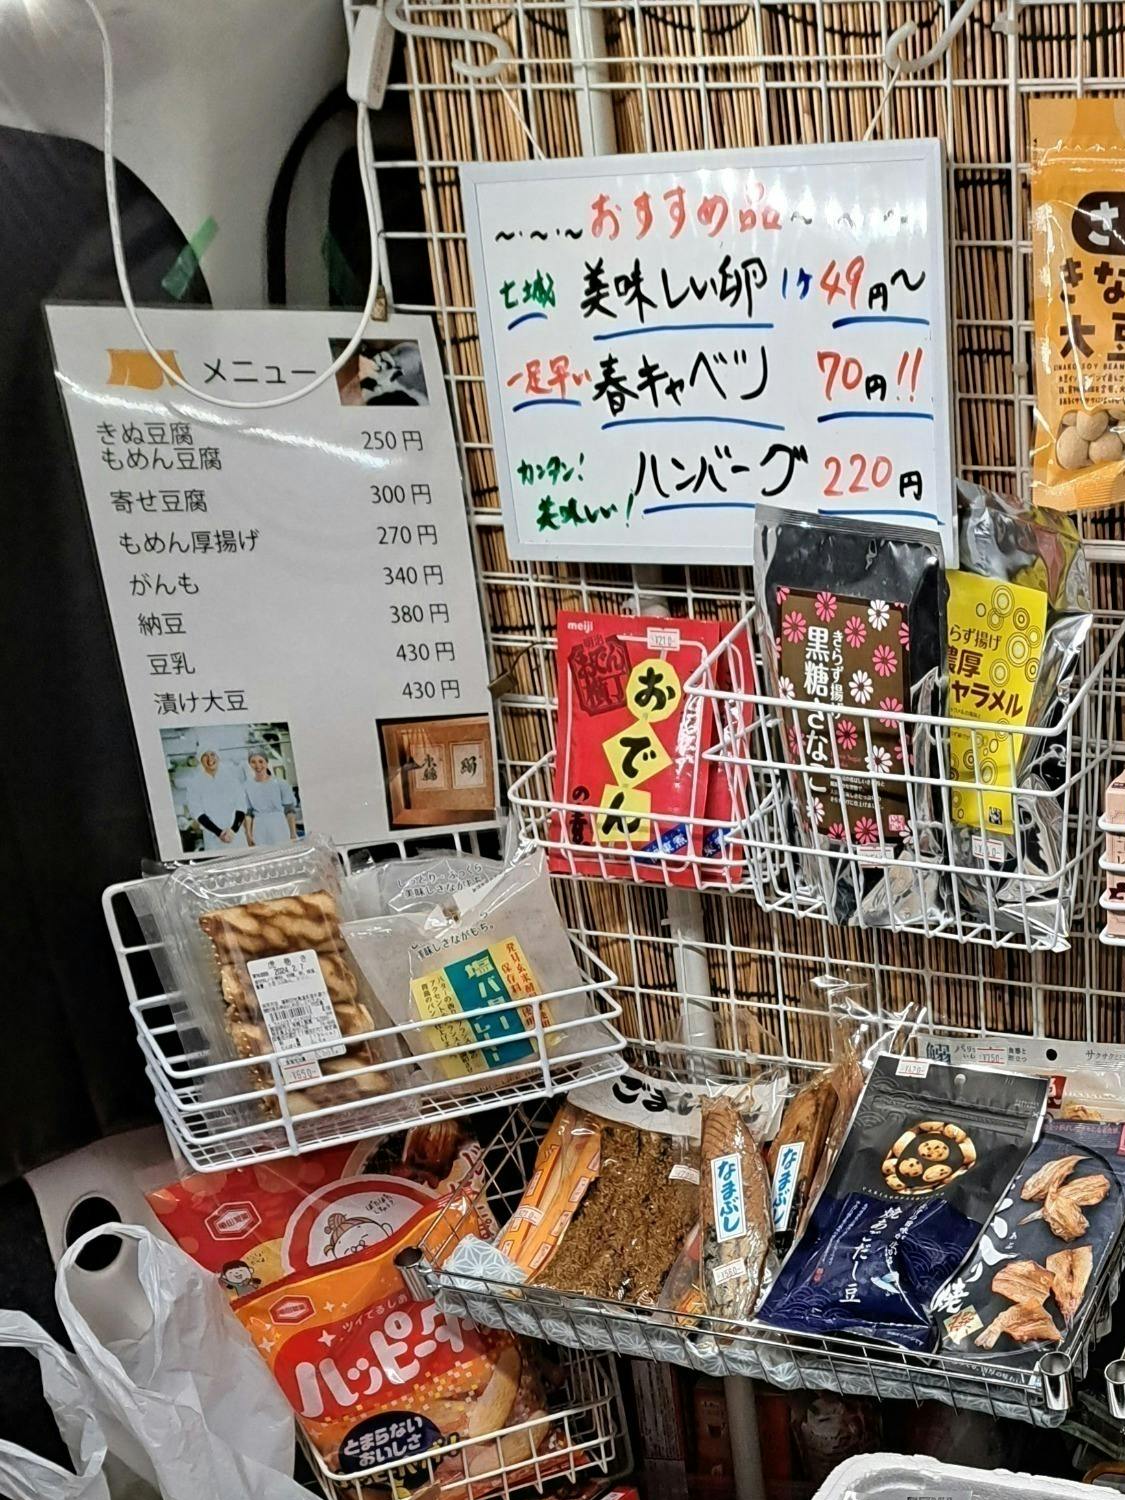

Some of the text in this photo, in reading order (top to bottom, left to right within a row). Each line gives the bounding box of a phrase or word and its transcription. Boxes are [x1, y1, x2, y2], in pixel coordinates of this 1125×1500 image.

[580, 254, 767, 322] 美味しい卵
[202, 358, 316, 386] メニュー
[592, 345, 767, 416] 春キャベツ
[1103, 363, 1125, 371] BEAN
[96, 421, 194, 447] きぬ豆腐
[100, 447, 223, 471] もめん豆腐
[634, 443, 808, 498] ハンバーグ
[824, 453, 922, 499] 220円
[110, 489, 208, 513] 寄せ豆腐
[118, 529, 259, 555] もめん厚揚げ
[129, 573, 200, 597] がんも
[138, 613, 187, 636] 納豆
[567, 620, 594, 635] meiji
[148, 652, 196, 676] 豆乳
[153, 689, 249, 715] 漬け大豆
[602, 666, 677, 834] おでん
[718, 1160, 741, 1232] なまぶし
[773, 1148, 797, 1225] なまぶし
[344, 1416, 423, 1456] とまらない
[359, 1433, 422, 1467] おいしさ
